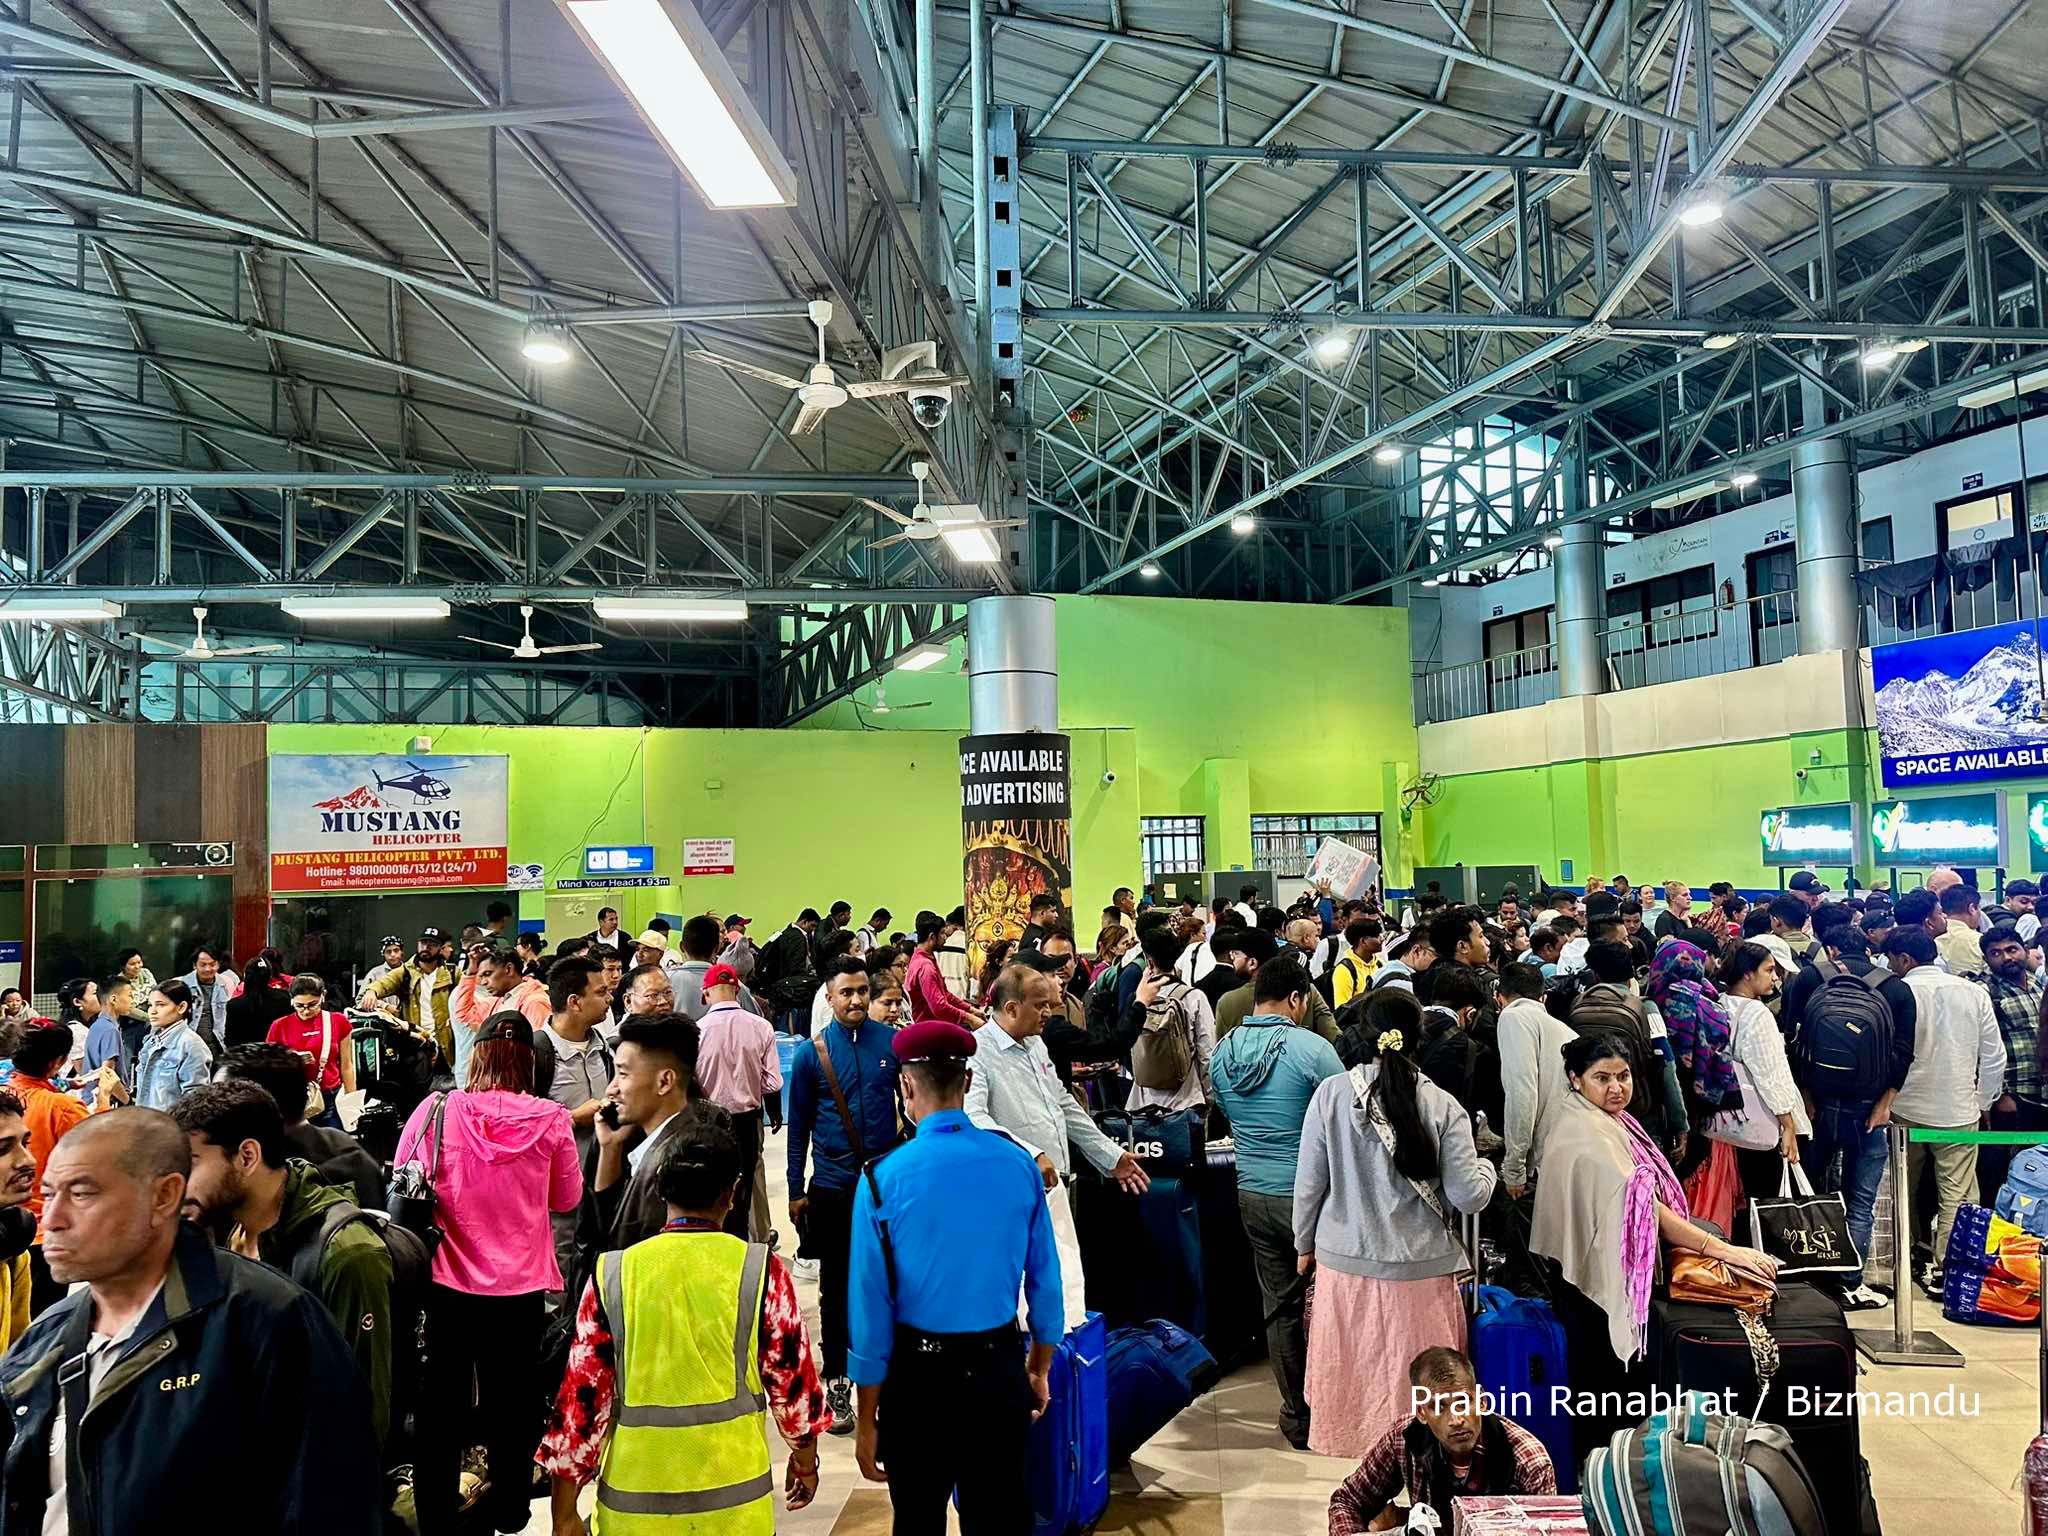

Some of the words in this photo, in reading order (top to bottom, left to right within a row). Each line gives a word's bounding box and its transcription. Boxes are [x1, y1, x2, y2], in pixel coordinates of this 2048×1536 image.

[980, 749, 1063, 773] AVAILABLE
[1896, 757, 1951, 776] SPACE
[966, 781, 1064, 806] ADVERTISING
[320, 809, 461, 833] MUSTANG
[372, 832, 462, 845] HELICOPTER
[274, 853, 340, 866] MUSTANG
[344, 850, 429, 863] HELICOPTER
[437, 849, 466, 861] PVT.
[473, 848, 502, 860] LTD.
[306, 866, 347, 878] Hotline:
[443, 860, 477, 875] (24/7)
[320, 878, 345, 887] Email:
[346, 874, 463, 887] helicoptermustang@gmail.com
[558, 880, 582, 889] Mind
[585, 879, 606, 888] Your
[159, 1373, 201, 1391] G.R.P
